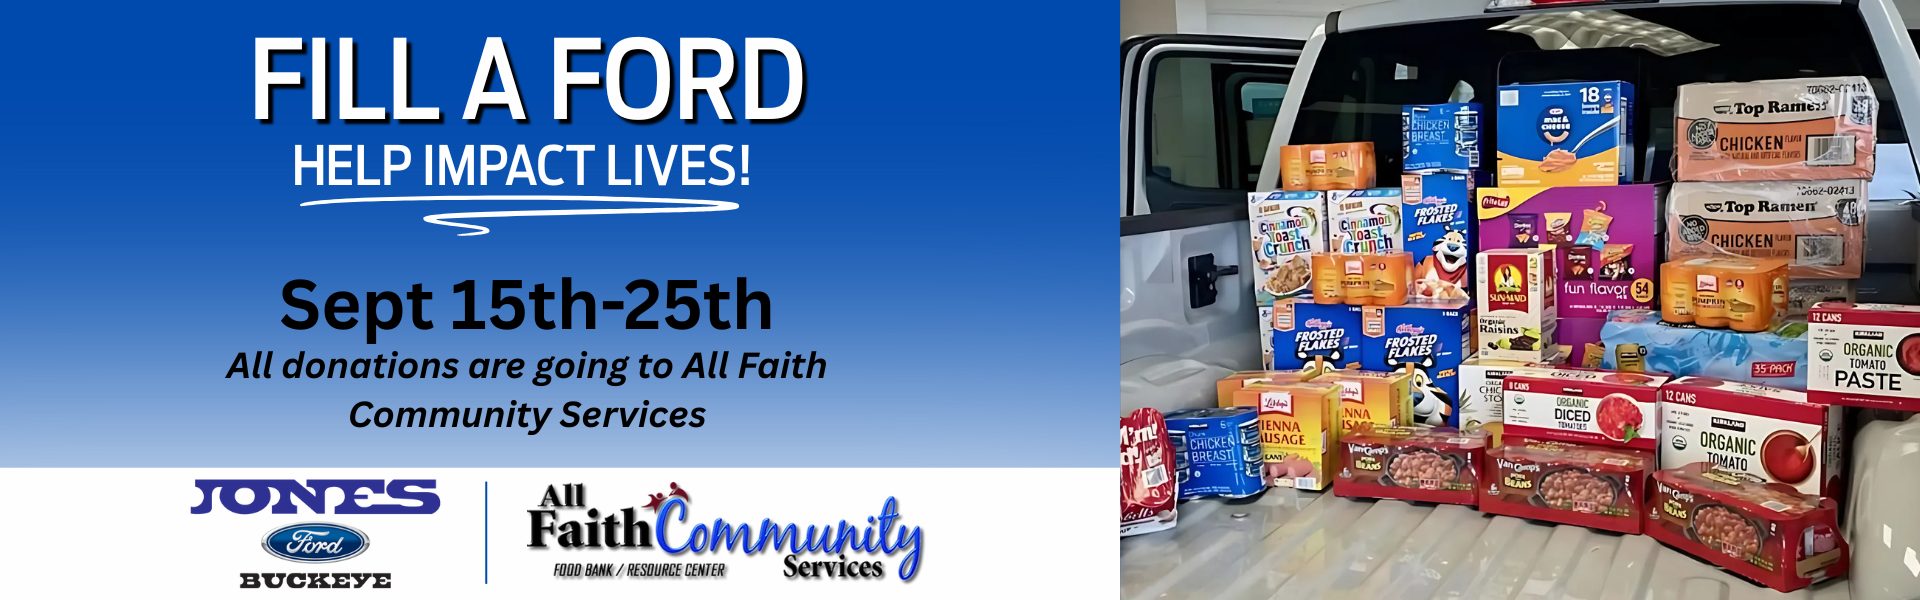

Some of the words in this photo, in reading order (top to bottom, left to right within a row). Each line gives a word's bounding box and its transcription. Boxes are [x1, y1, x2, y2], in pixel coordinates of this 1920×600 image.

[1580, 87, 1600, 103] 18
[1735, 102, 1764, 117] Top
[1768, 100, 1827, 114] Ramen
[1412, 120, 1450, 130] CHICKEN
[1412, 131, 1446, 142] BREAST
[1720, 136, 1784, 151] CHICKEN
[1414, 204, 1458, 218] FROSTED
[1725, 201, 1754, 216] Top
[1758, 201, 1818, 213] Ramen
[1259, 218, 1308, 234] Cinnamon
[1340, 215, 1392, 232] Cinnamon
[1417, 213, 1454, 226] FLAKES
[1270, 228, 1300, 243] Toast
[1352, 226, 1384, 241] Toast
[1264, 236, 1310, 257] Crunch
[1344, 235, 1393, 254] Crunch
[1712, 234, 1773, 248] CHICKEN
[1564, 282, 1585, 294] fun
[1590, 282, 1628, 295] flavor
[1636, 282, 1648, 294] 54
[1813, 312, 1820, 322] 12
[1822, 313, 1842, 322] CANS
[1295, 328, 1344, 342] FROSTED
[1480, 324, 1519, 334] Raisins
[1298, 339, 1340, 352] FLAKES
[1385, 334, 1438, 349] FROSTED
[1388, 345, 1432, 358] FLAKES
[1844, 342, 1893, 358] ORGANIC
[1754, 363, 1766, 374] 35
[1769, 362, 1794, 374] PACK
[1850, 358, 1886, 370] TOMATO
[1514, 382, 1530, 391] CANS
[1835, 370, 1902, 391] PASTE
[1556, 397, 1589, 409] ORGANIC
[1666, 390, 1674, 401] 12
[1676, 392, 1696, 404] CANS
[1555, 408, 1591, 422] DICED
[1262, 420, 1301, 432] IENNA
[1190, 436, 1235, 450] CHICKEN
[1260, 433, 1306, 445] AUSAGE
[1700, 431, 1756, 456] ORGANIC
[1192, 450, 1233, 462] BREAST
[1707, 452, 1748, 472] TOMATO
[1497, 458, 1513, 469] Van
[1504, 478, 1532, 489] BEANS
[1664, 502, 1687, 519] BEANS
